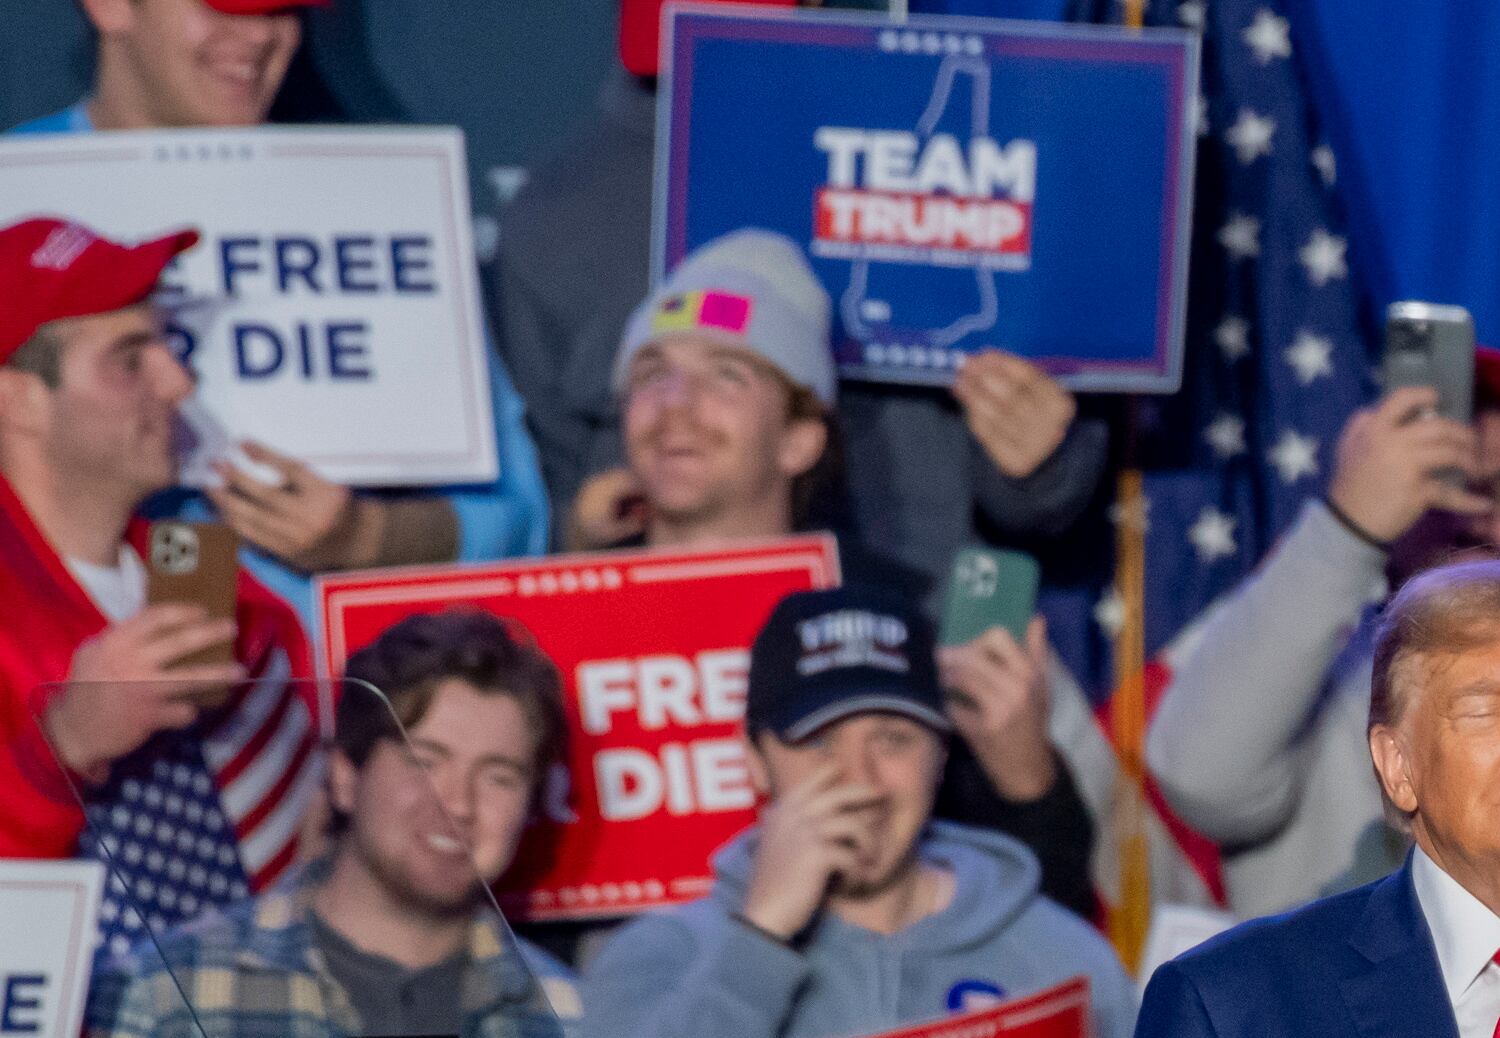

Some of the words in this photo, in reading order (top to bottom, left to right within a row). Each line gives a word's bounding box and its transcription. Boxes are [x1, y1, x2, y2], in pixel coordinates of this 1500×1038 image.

[814, 126, 1037, 204] TEAM
[820, 192, 1026, 249] TRUMP
[219, 234, 438, 294] FREE
[233, 320, 373, 379] DIE
[575, 648, 752, 736] FRE
[592, 738, 756, 822] DIE
